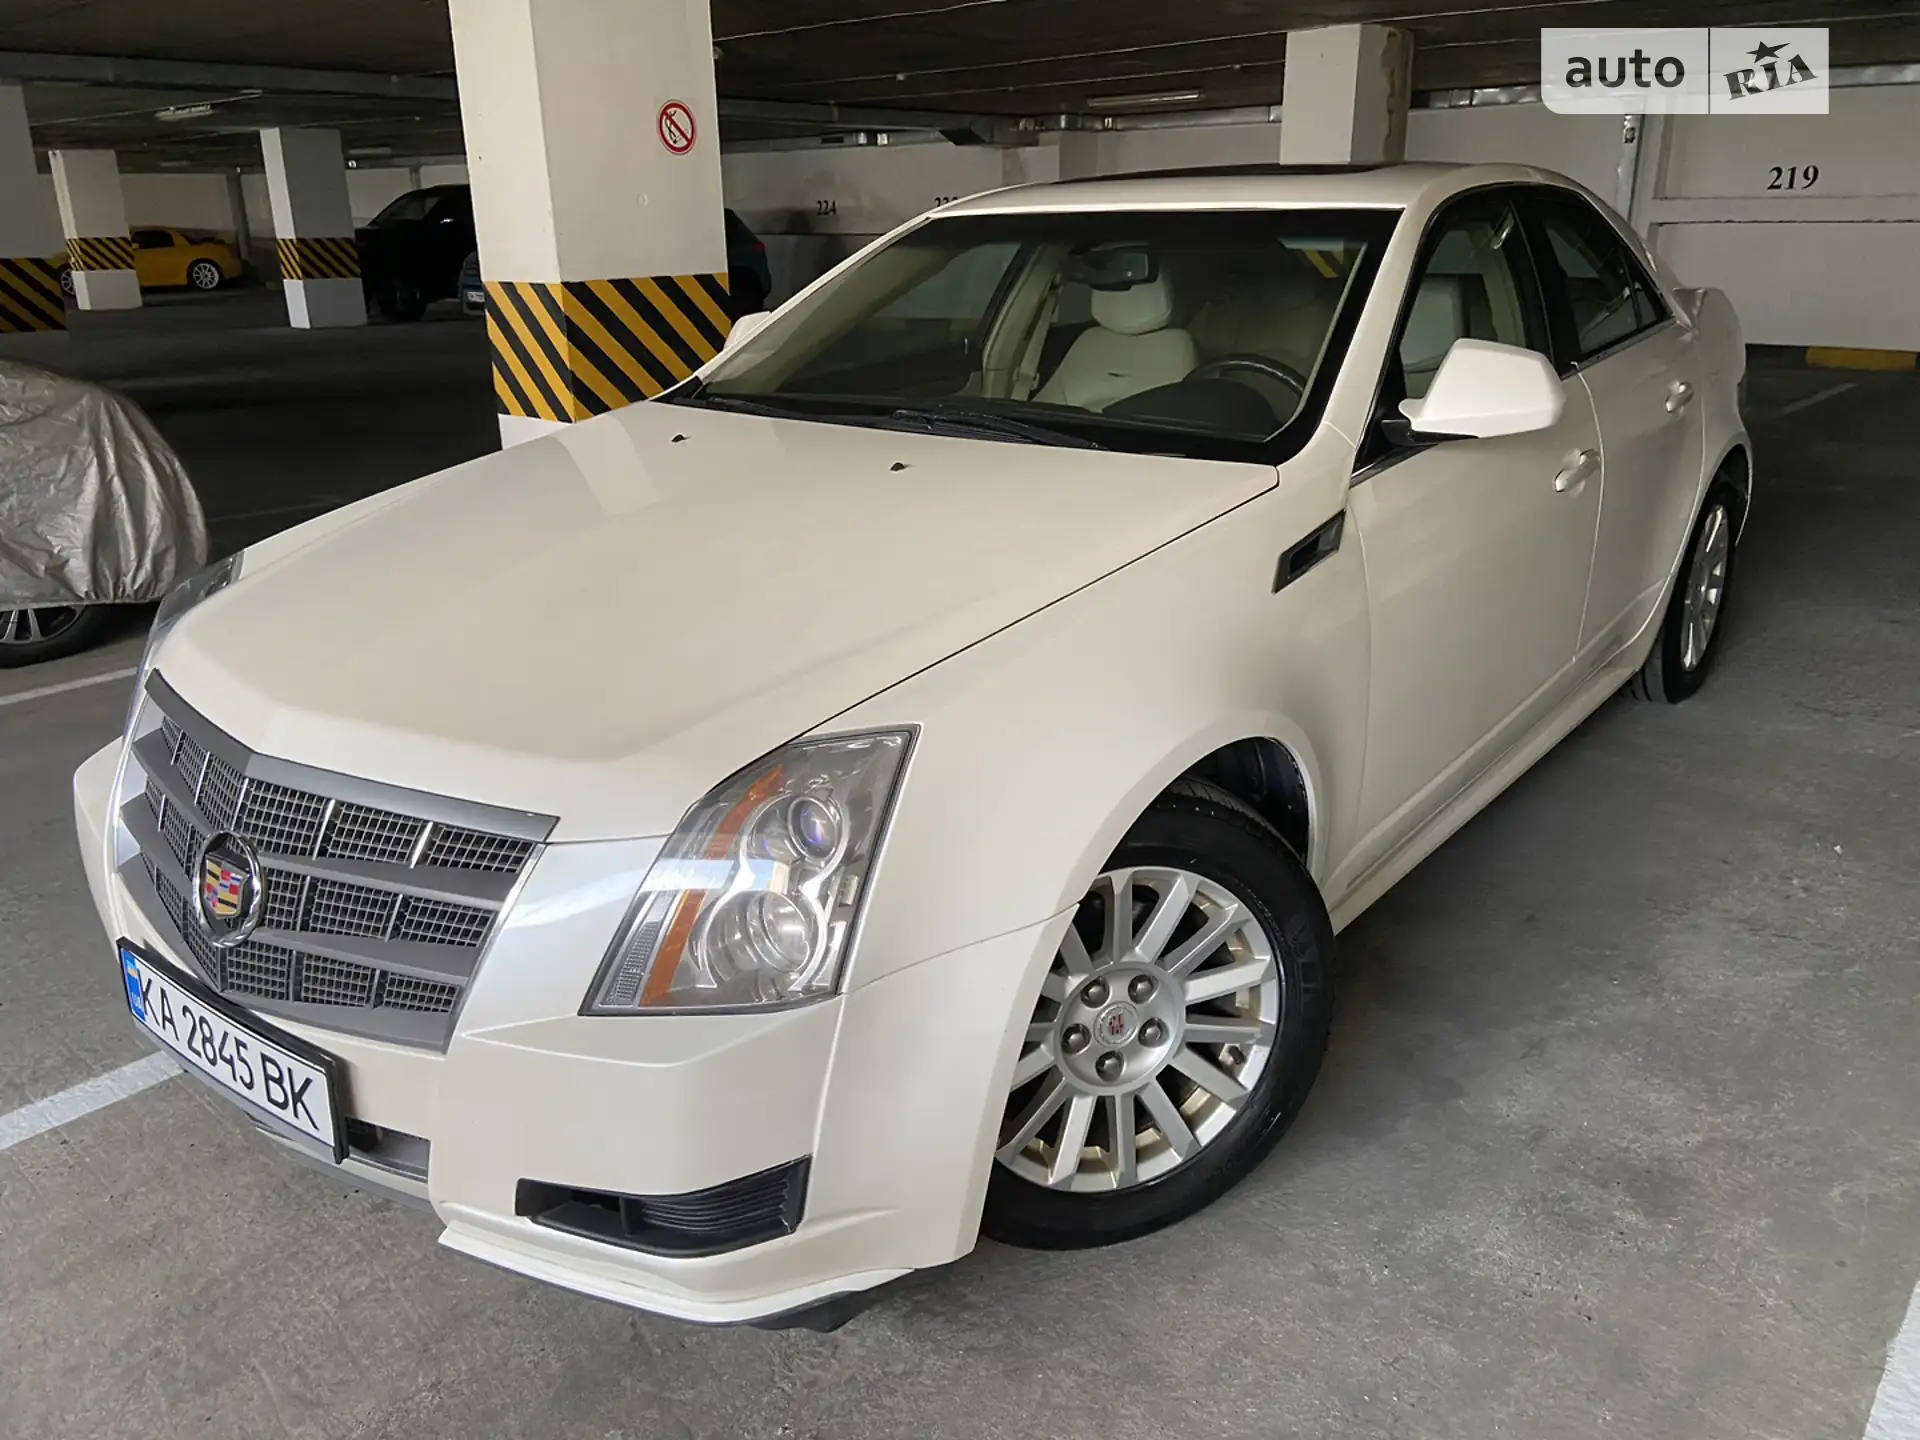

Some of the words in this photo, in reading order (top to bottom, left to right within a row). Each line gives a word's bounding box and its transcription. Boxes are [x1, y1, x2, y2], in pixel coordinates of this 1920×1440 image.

[1766, 164, 1820, 190] 219
[816, 200, 837, 215] 224
[138, 968, 178, 1042] KA
[182, 1004, 254, 1091] 2845
[260, 1051, 319, 1131] BK
